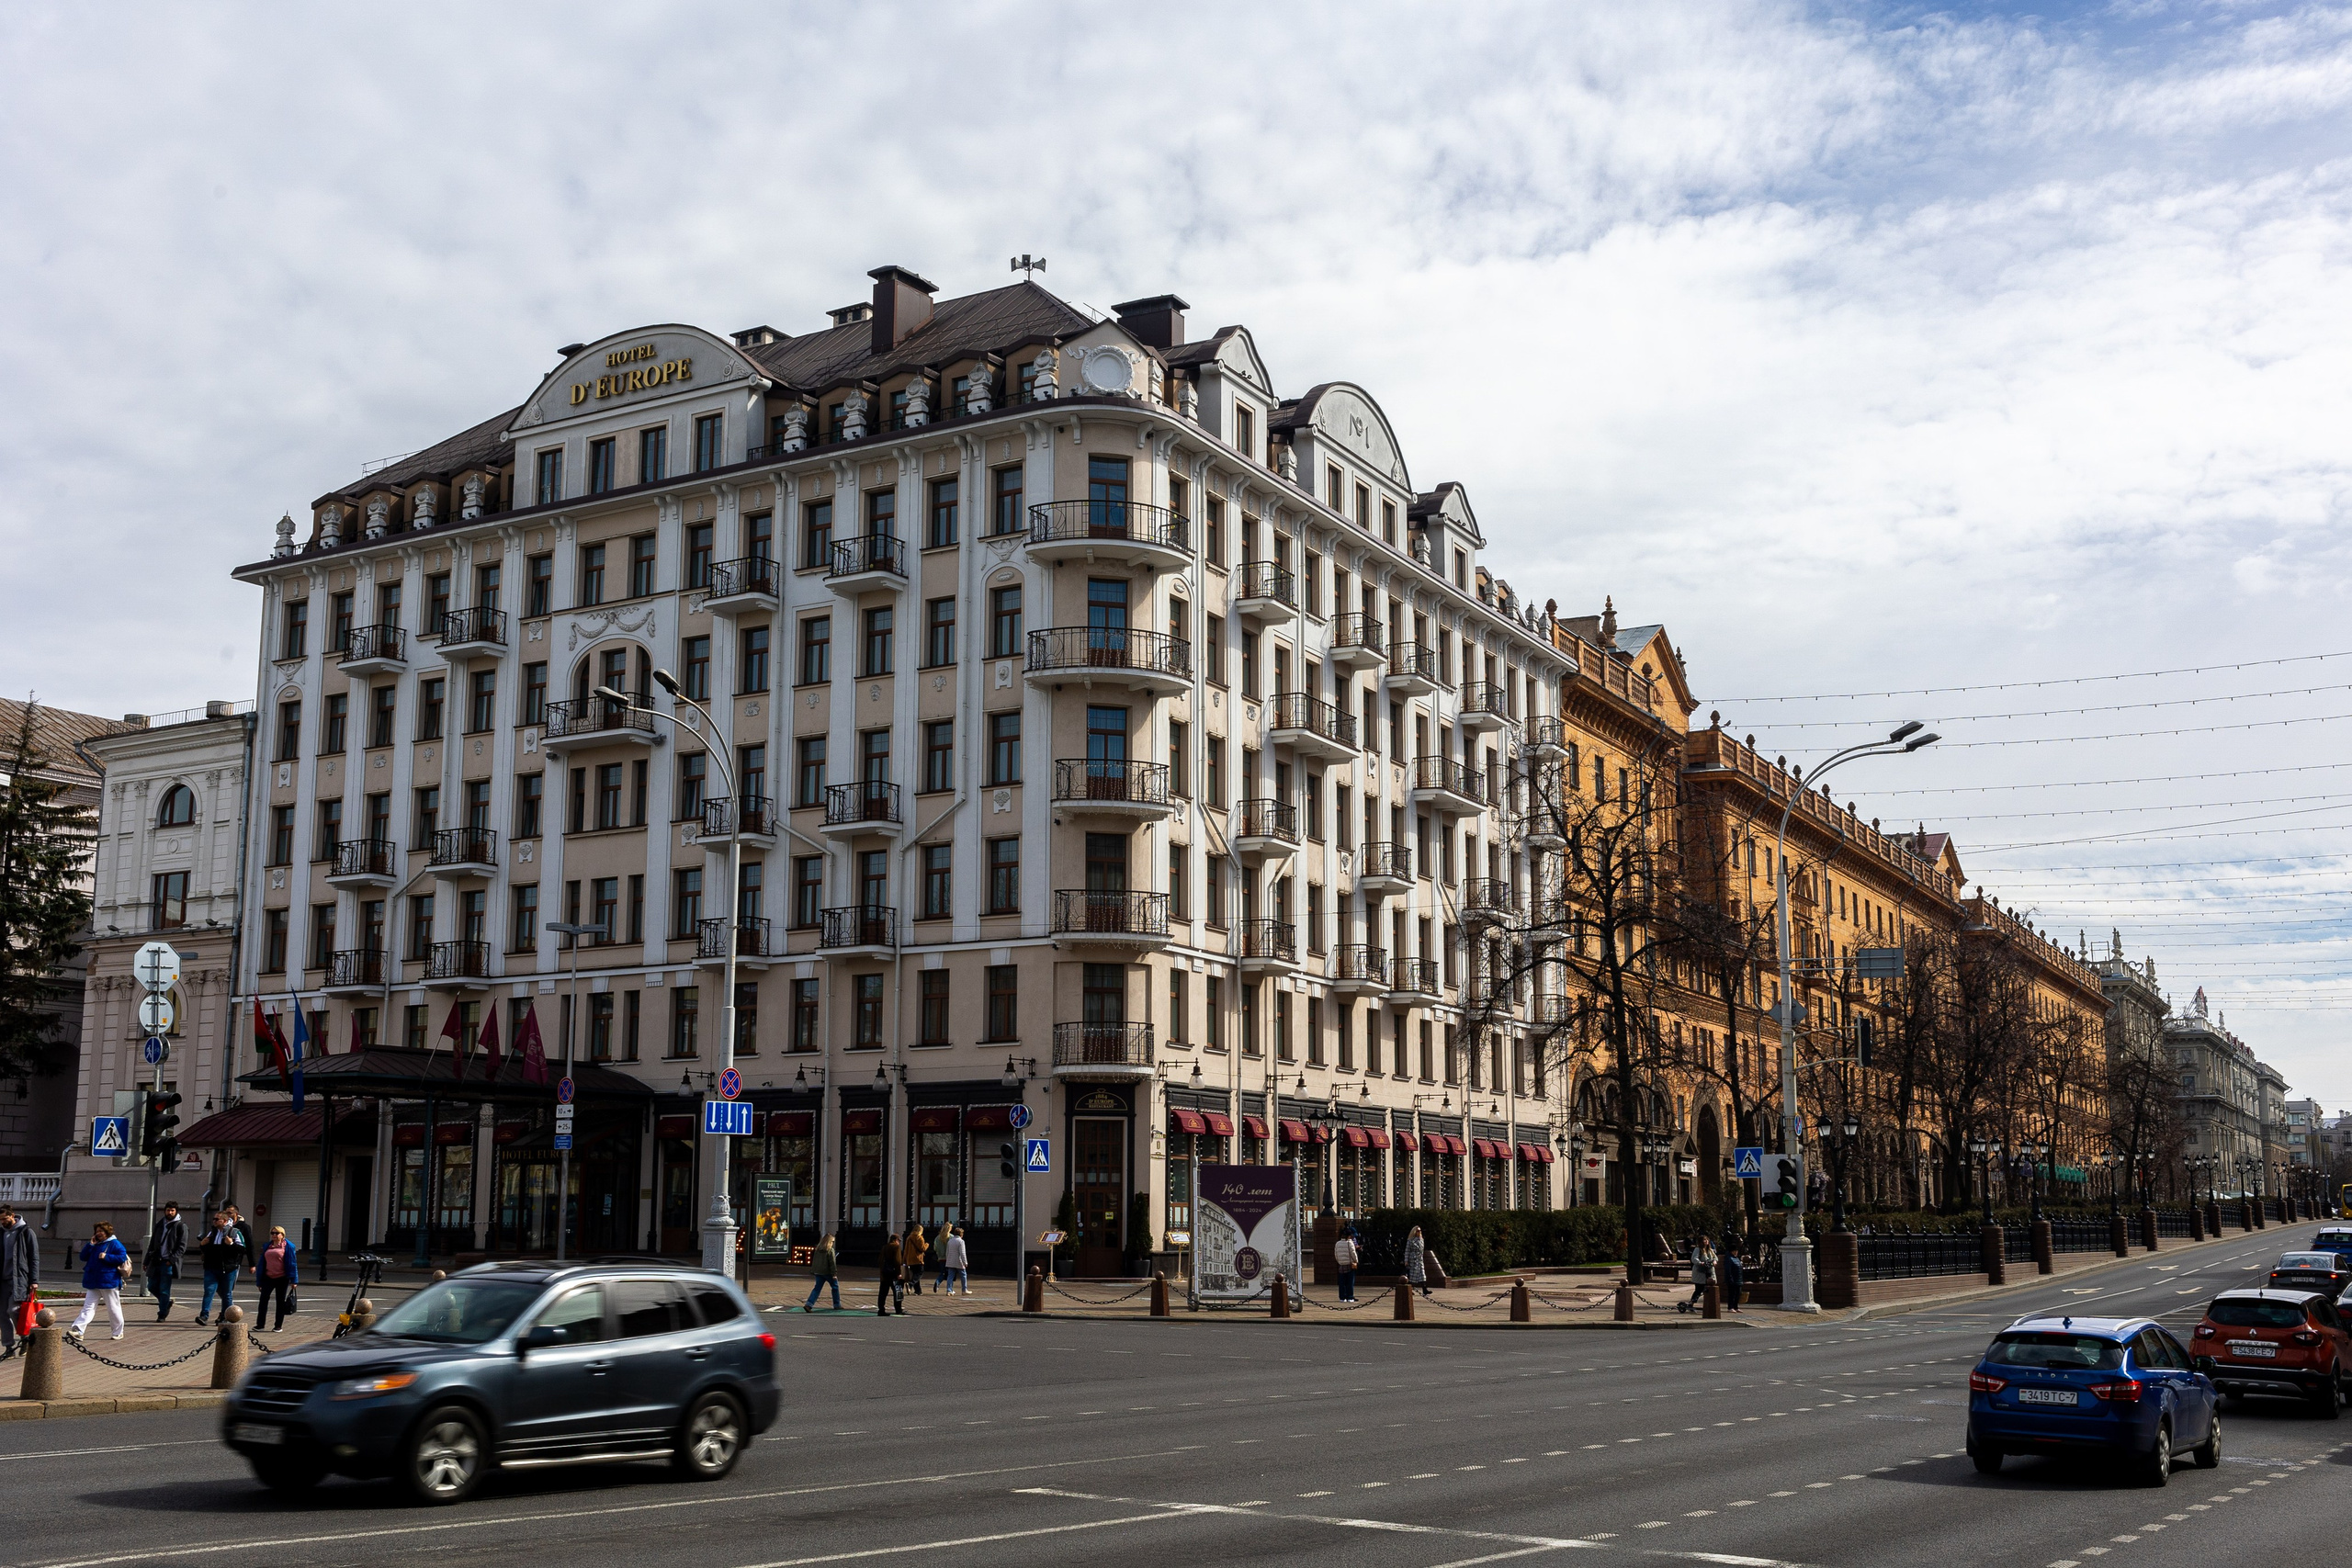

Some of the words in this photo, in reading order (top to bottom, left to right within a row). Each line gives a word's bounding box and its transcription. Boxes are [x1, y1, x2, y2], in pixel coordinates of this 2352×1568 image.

[605, 344, 656, 367] HOTEL
[502, 1149, 532, 1159] HOTEL
[537, 1149, 575, 1158] EUROE
[1222, 1183, 1244, 1195] 140
[2238, 1347, 2255, 1355] 5438
[2028, 1390, 2049, 1401] 3419
